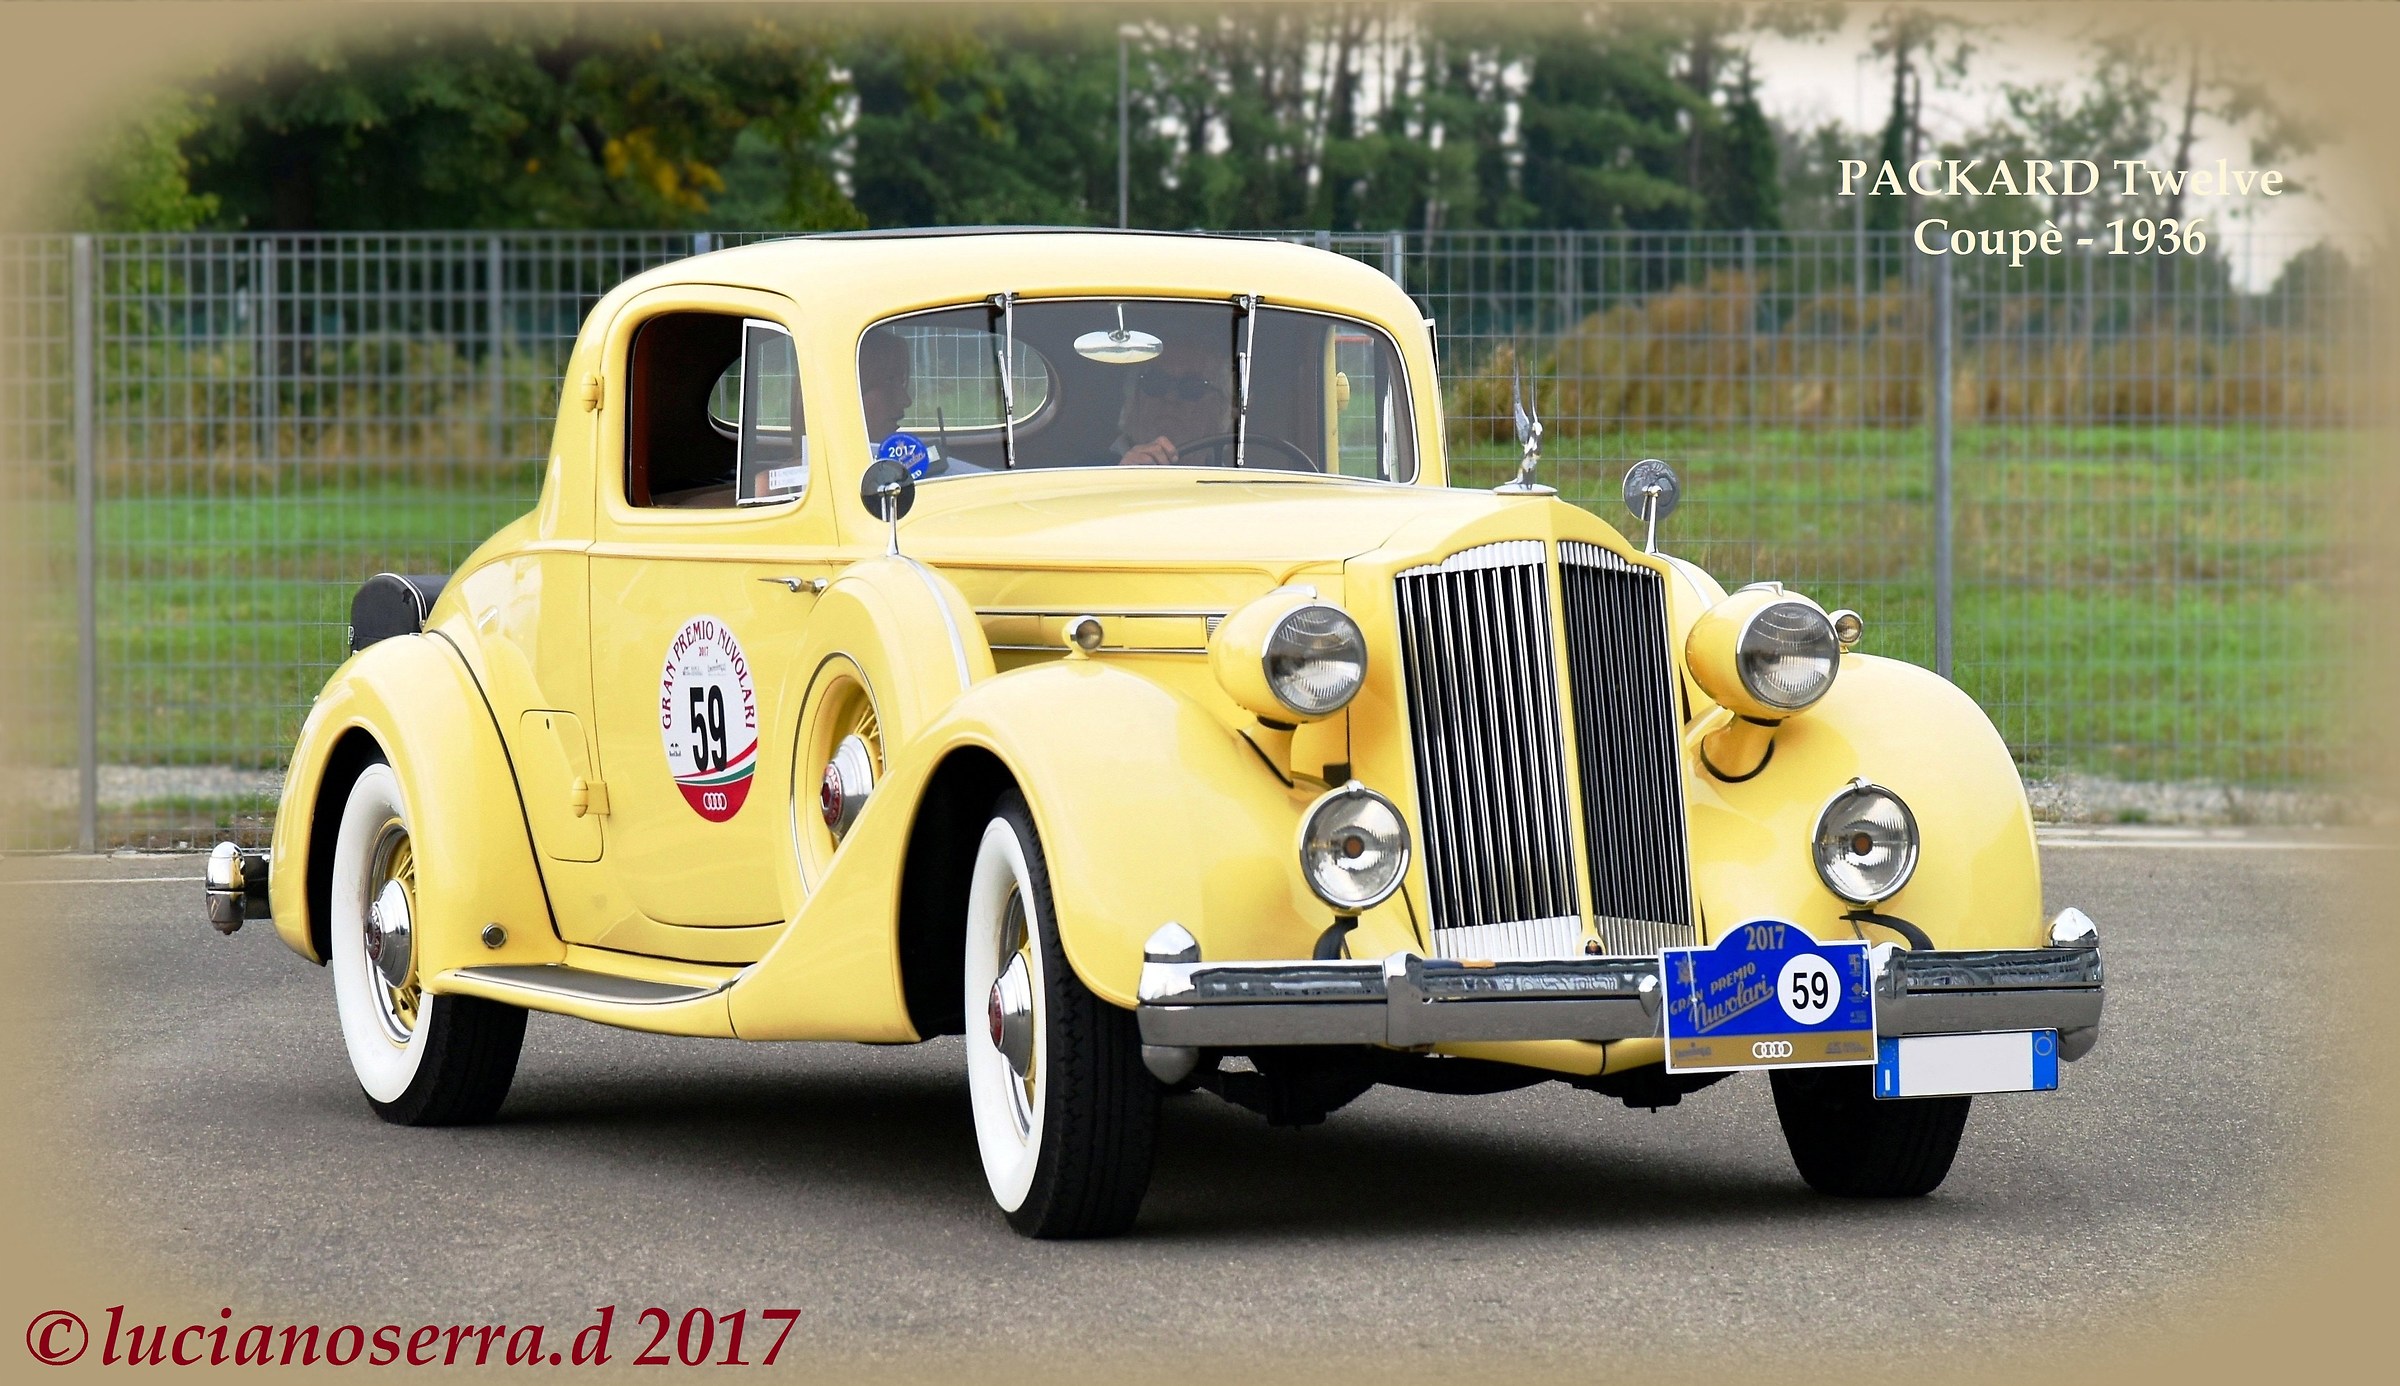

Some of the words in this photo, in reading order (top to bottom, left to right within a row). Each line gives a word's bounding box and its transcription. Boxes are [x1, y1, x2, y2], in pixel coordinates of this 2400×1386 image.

[889, 445, 916, 458] 2017
[662, 661, 676, 730] GRAN
[673, 620, 713, 662] PREMIO
[718, 628, 756, 729] NUVOLARI
[689, 685, 727, 772] 59
[1744, 925, 1785, 951] 2017
[1710, 962, 1756, 995] PREMIO
[1792, 971, 1829, 1010] 59
[1688, 974, 1774, 1034] Nuvolari
